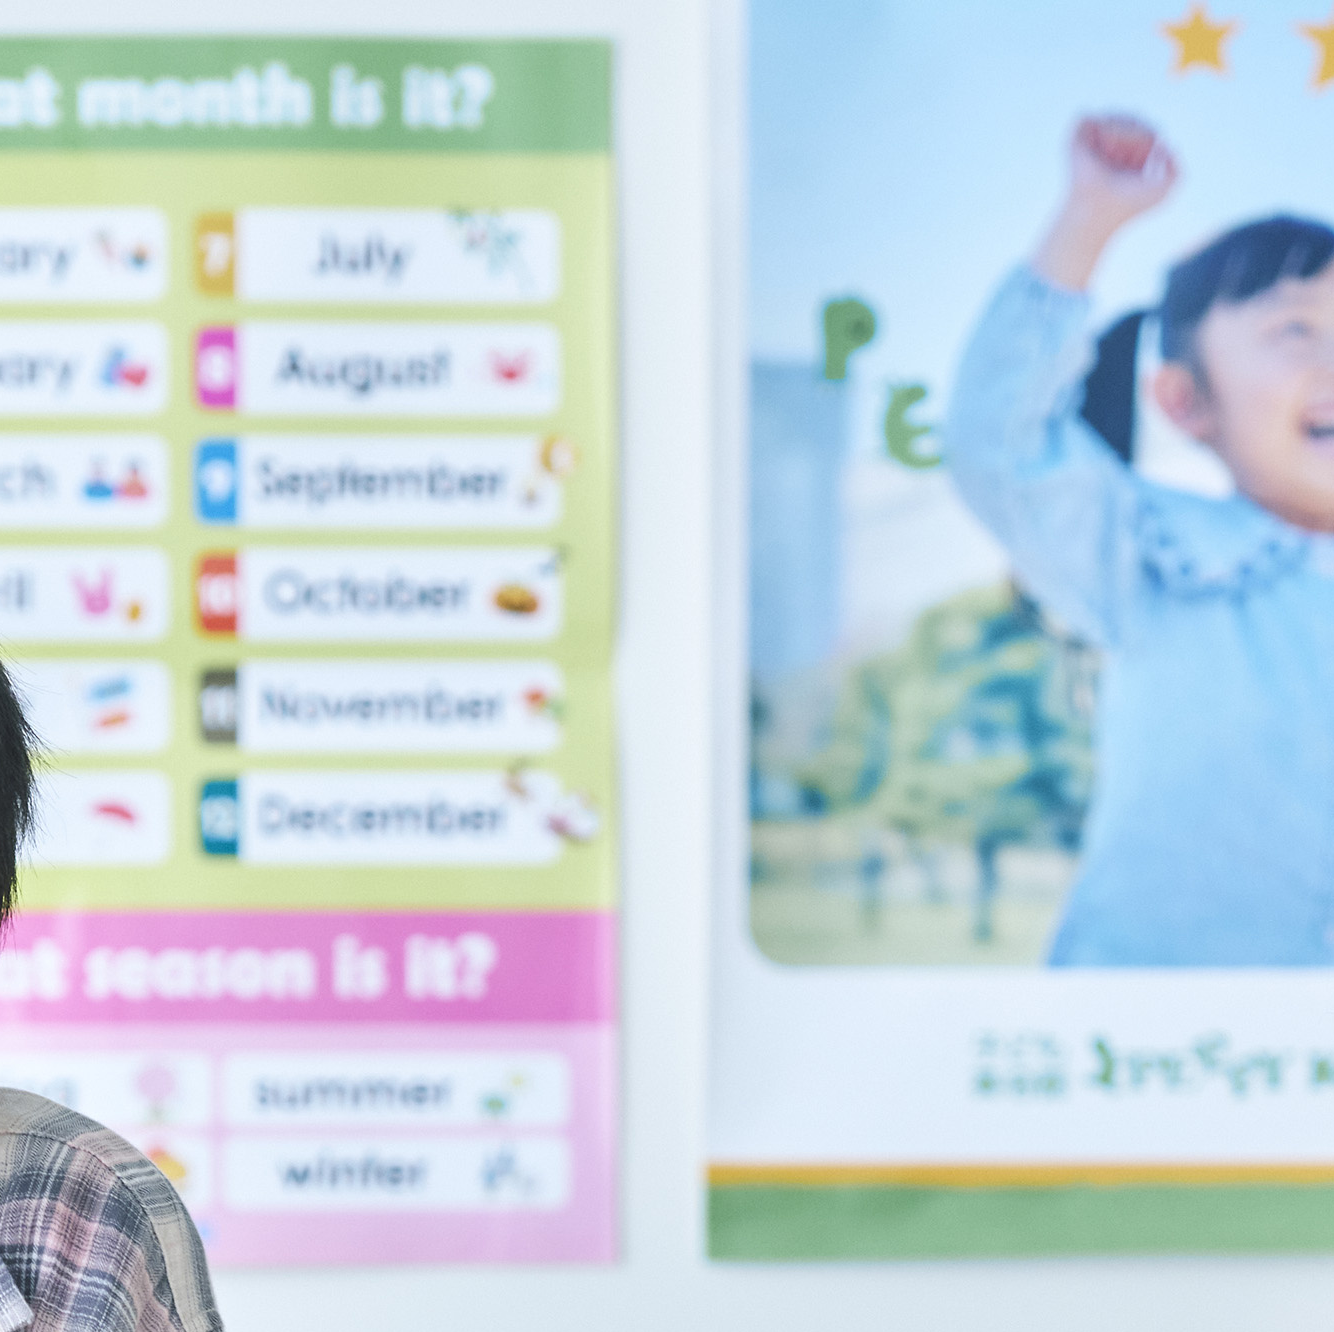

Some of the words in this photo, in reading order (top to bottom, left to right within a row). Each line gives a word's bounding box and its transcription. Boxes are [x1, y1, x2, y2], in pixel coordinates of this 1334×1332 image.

[77, 67, 314, 129] month
[332, 65, 384, 128] is
[402, 65, 497, 129] it?
[315, 234, 413, 284] July
[274, 346, 453, 398] August
[257, 460, 506, 510] September
[263, 572, 469, 620] October
[261, 683, 505, 726] November
[259, 790, 505, 834] December
[83, 947, 317, 1000] season
[333, 937, 386, 1000] is
[404, 934, 499, 1000] it?
[254, 1078, 454, 1114] summer
[280, 1153, 431, 1192] winter
